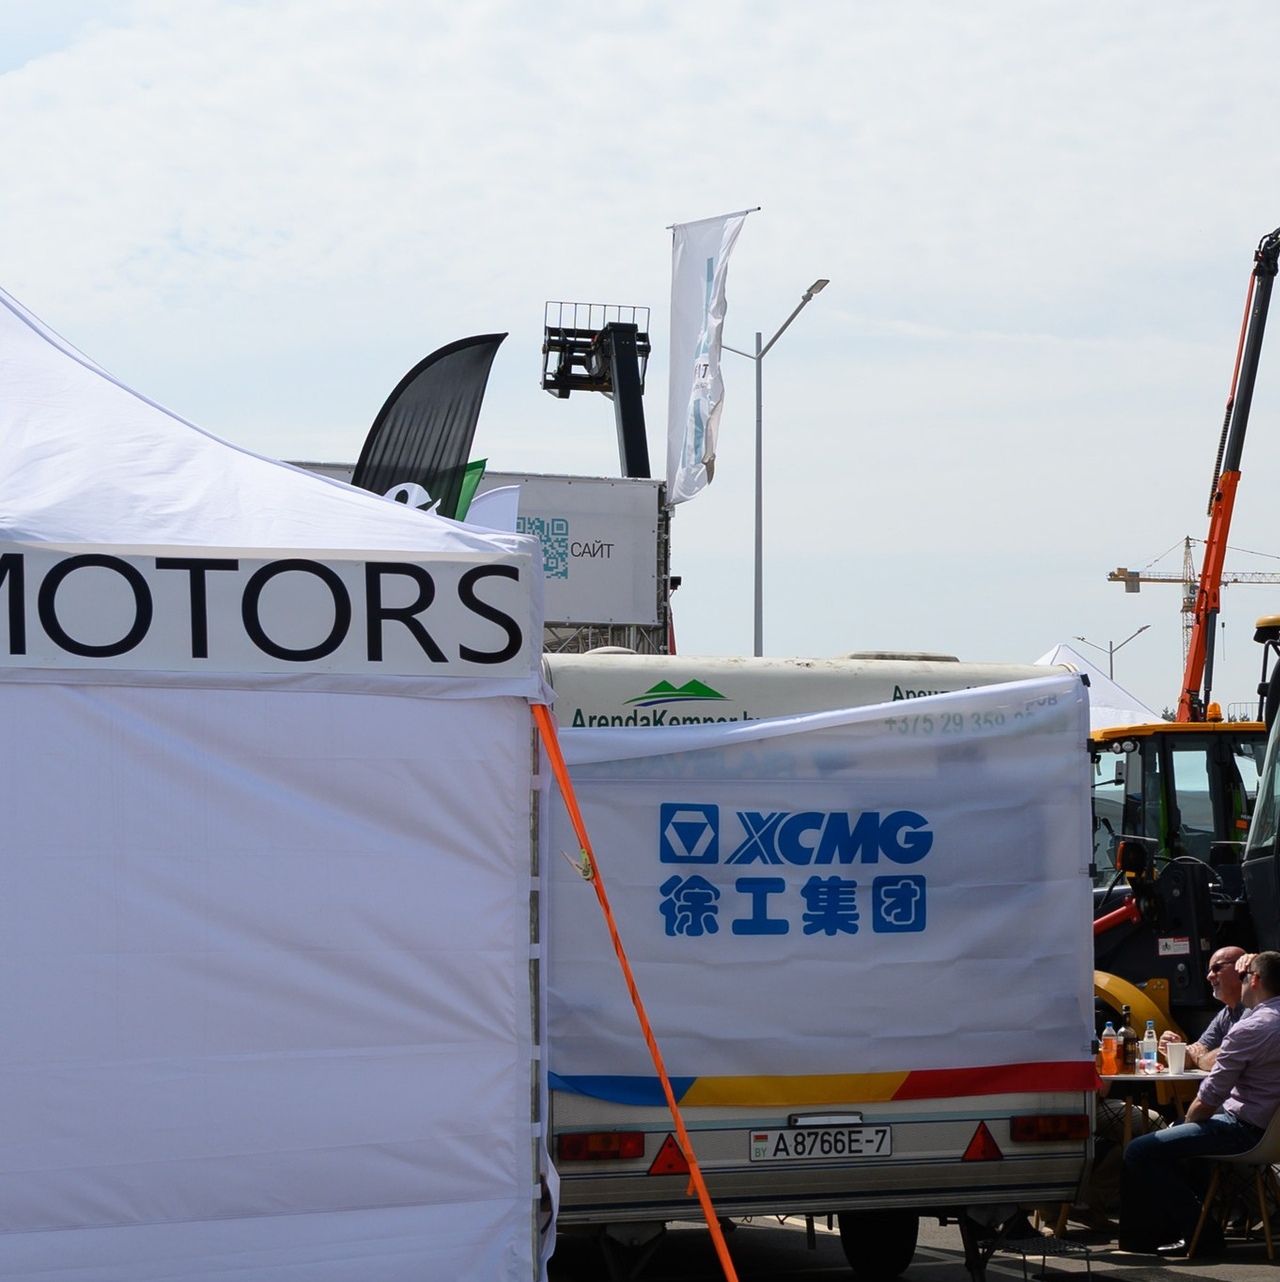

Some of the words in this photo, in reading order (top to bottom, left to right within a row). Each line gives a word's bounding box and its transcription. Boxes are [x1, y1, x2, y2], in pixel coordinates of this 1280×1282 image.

[570, 539, 615, 559] САЙТ
[0, 553, 524, 665] OTORS
[723, 810, 934, 866] XCMG
[659, 874, 927, 937] 徐工集团
[754, 1147, 767, 1158] BY
